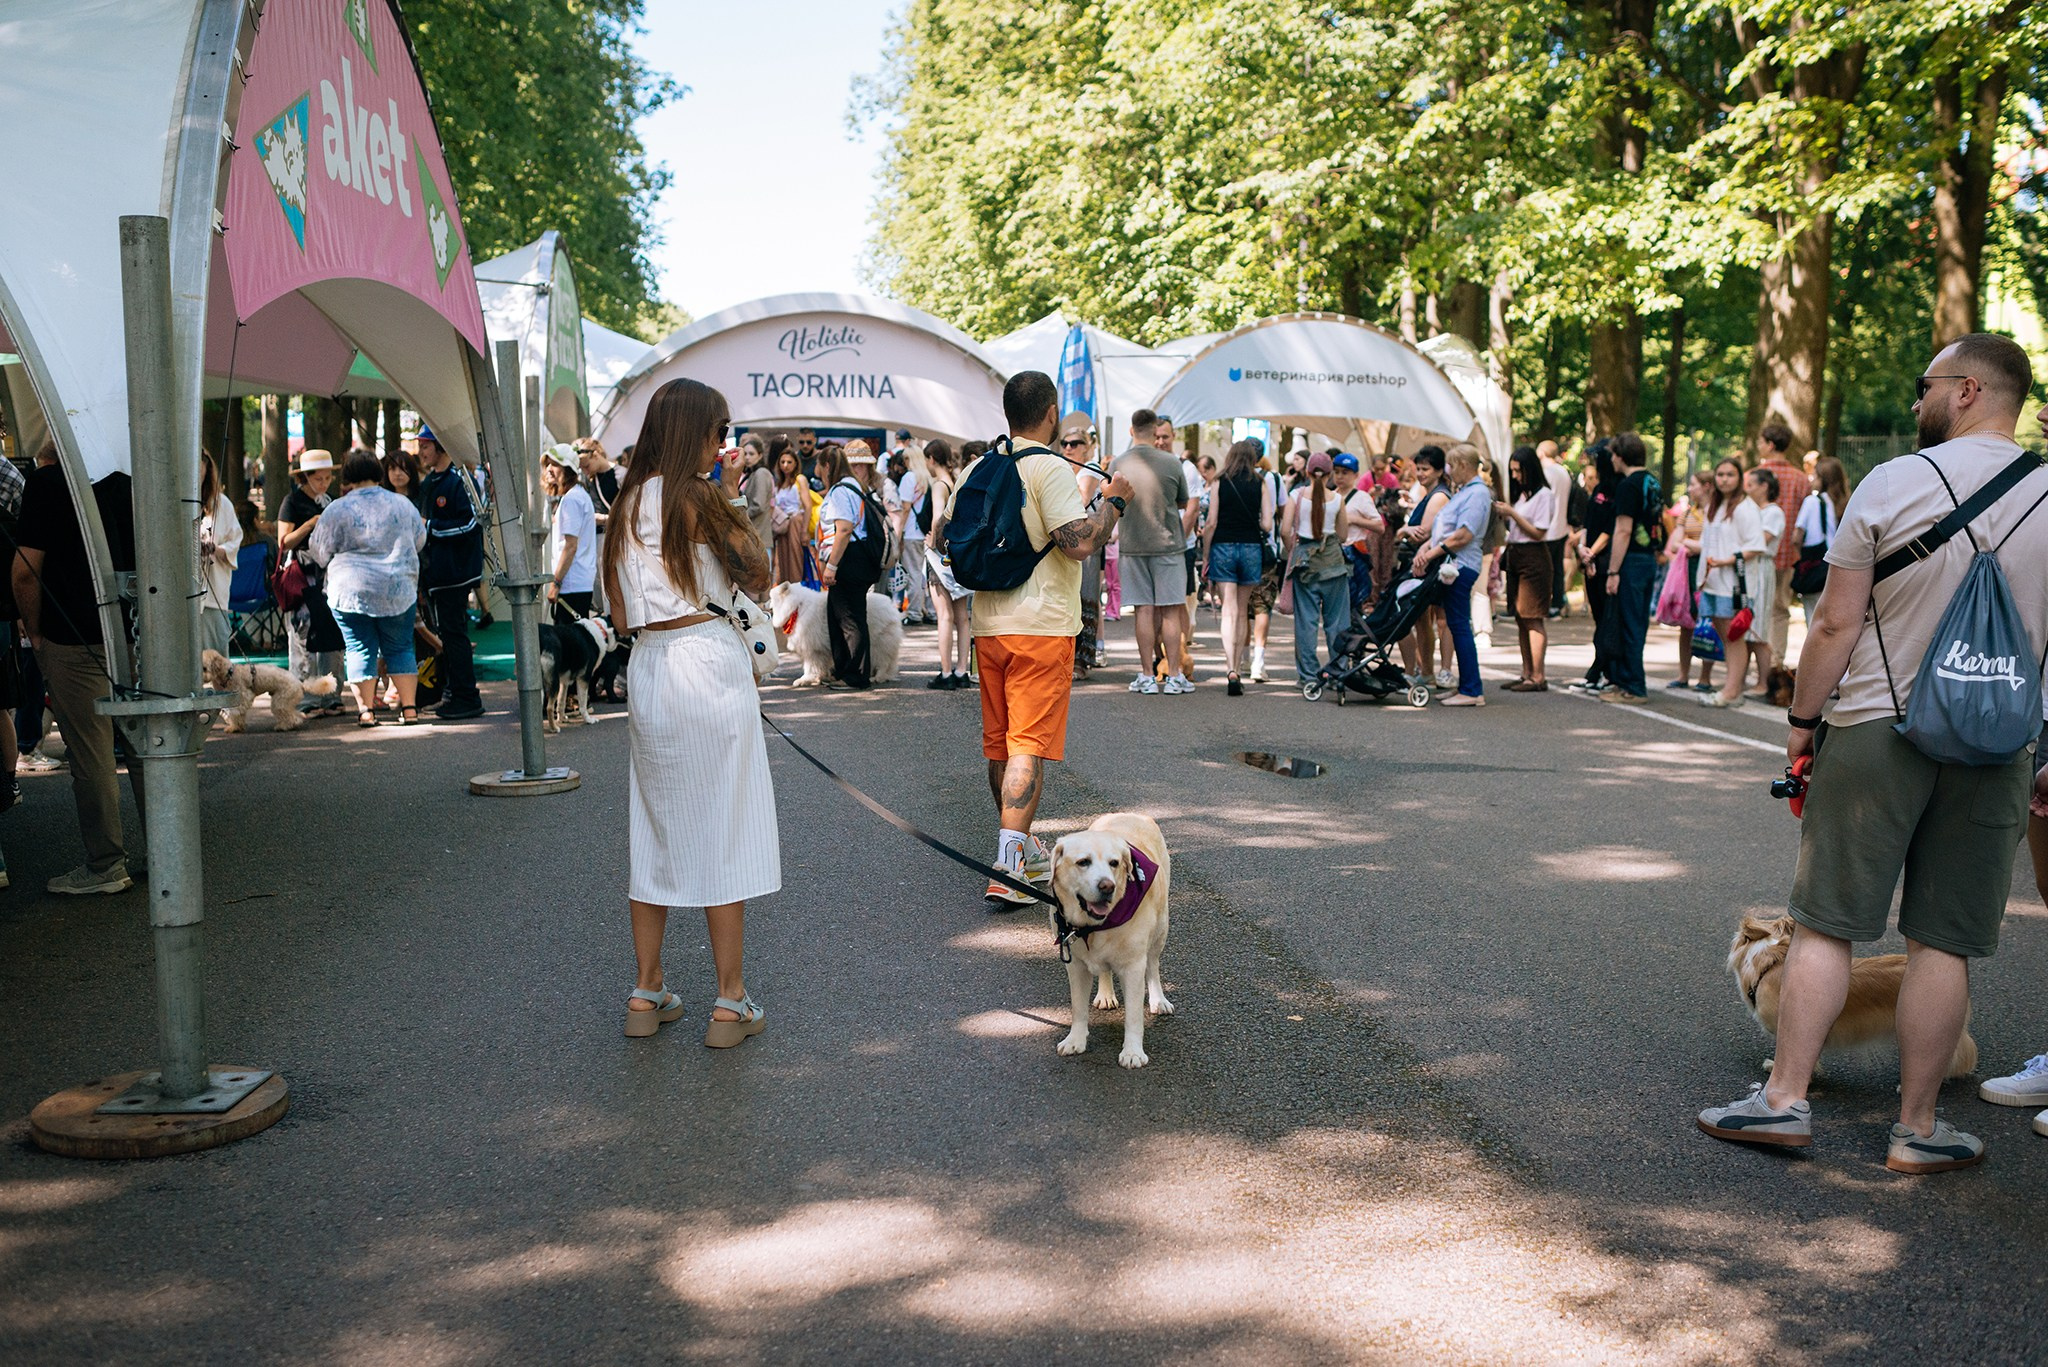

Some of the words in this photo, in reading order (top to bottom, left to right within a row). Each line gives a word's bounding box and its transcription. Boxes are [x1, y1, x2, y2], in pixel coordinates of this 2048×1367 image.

[320, 55, 412, 218] aket
[778, 325, 866, 361] Holistic
[747, 373, 896, 399] TAORMINA
[1245, 369, 1344, 384] ветеринария
[1347, 373, 1407, 388] petshop
[1937, 640, 2026, 691] Karmy
